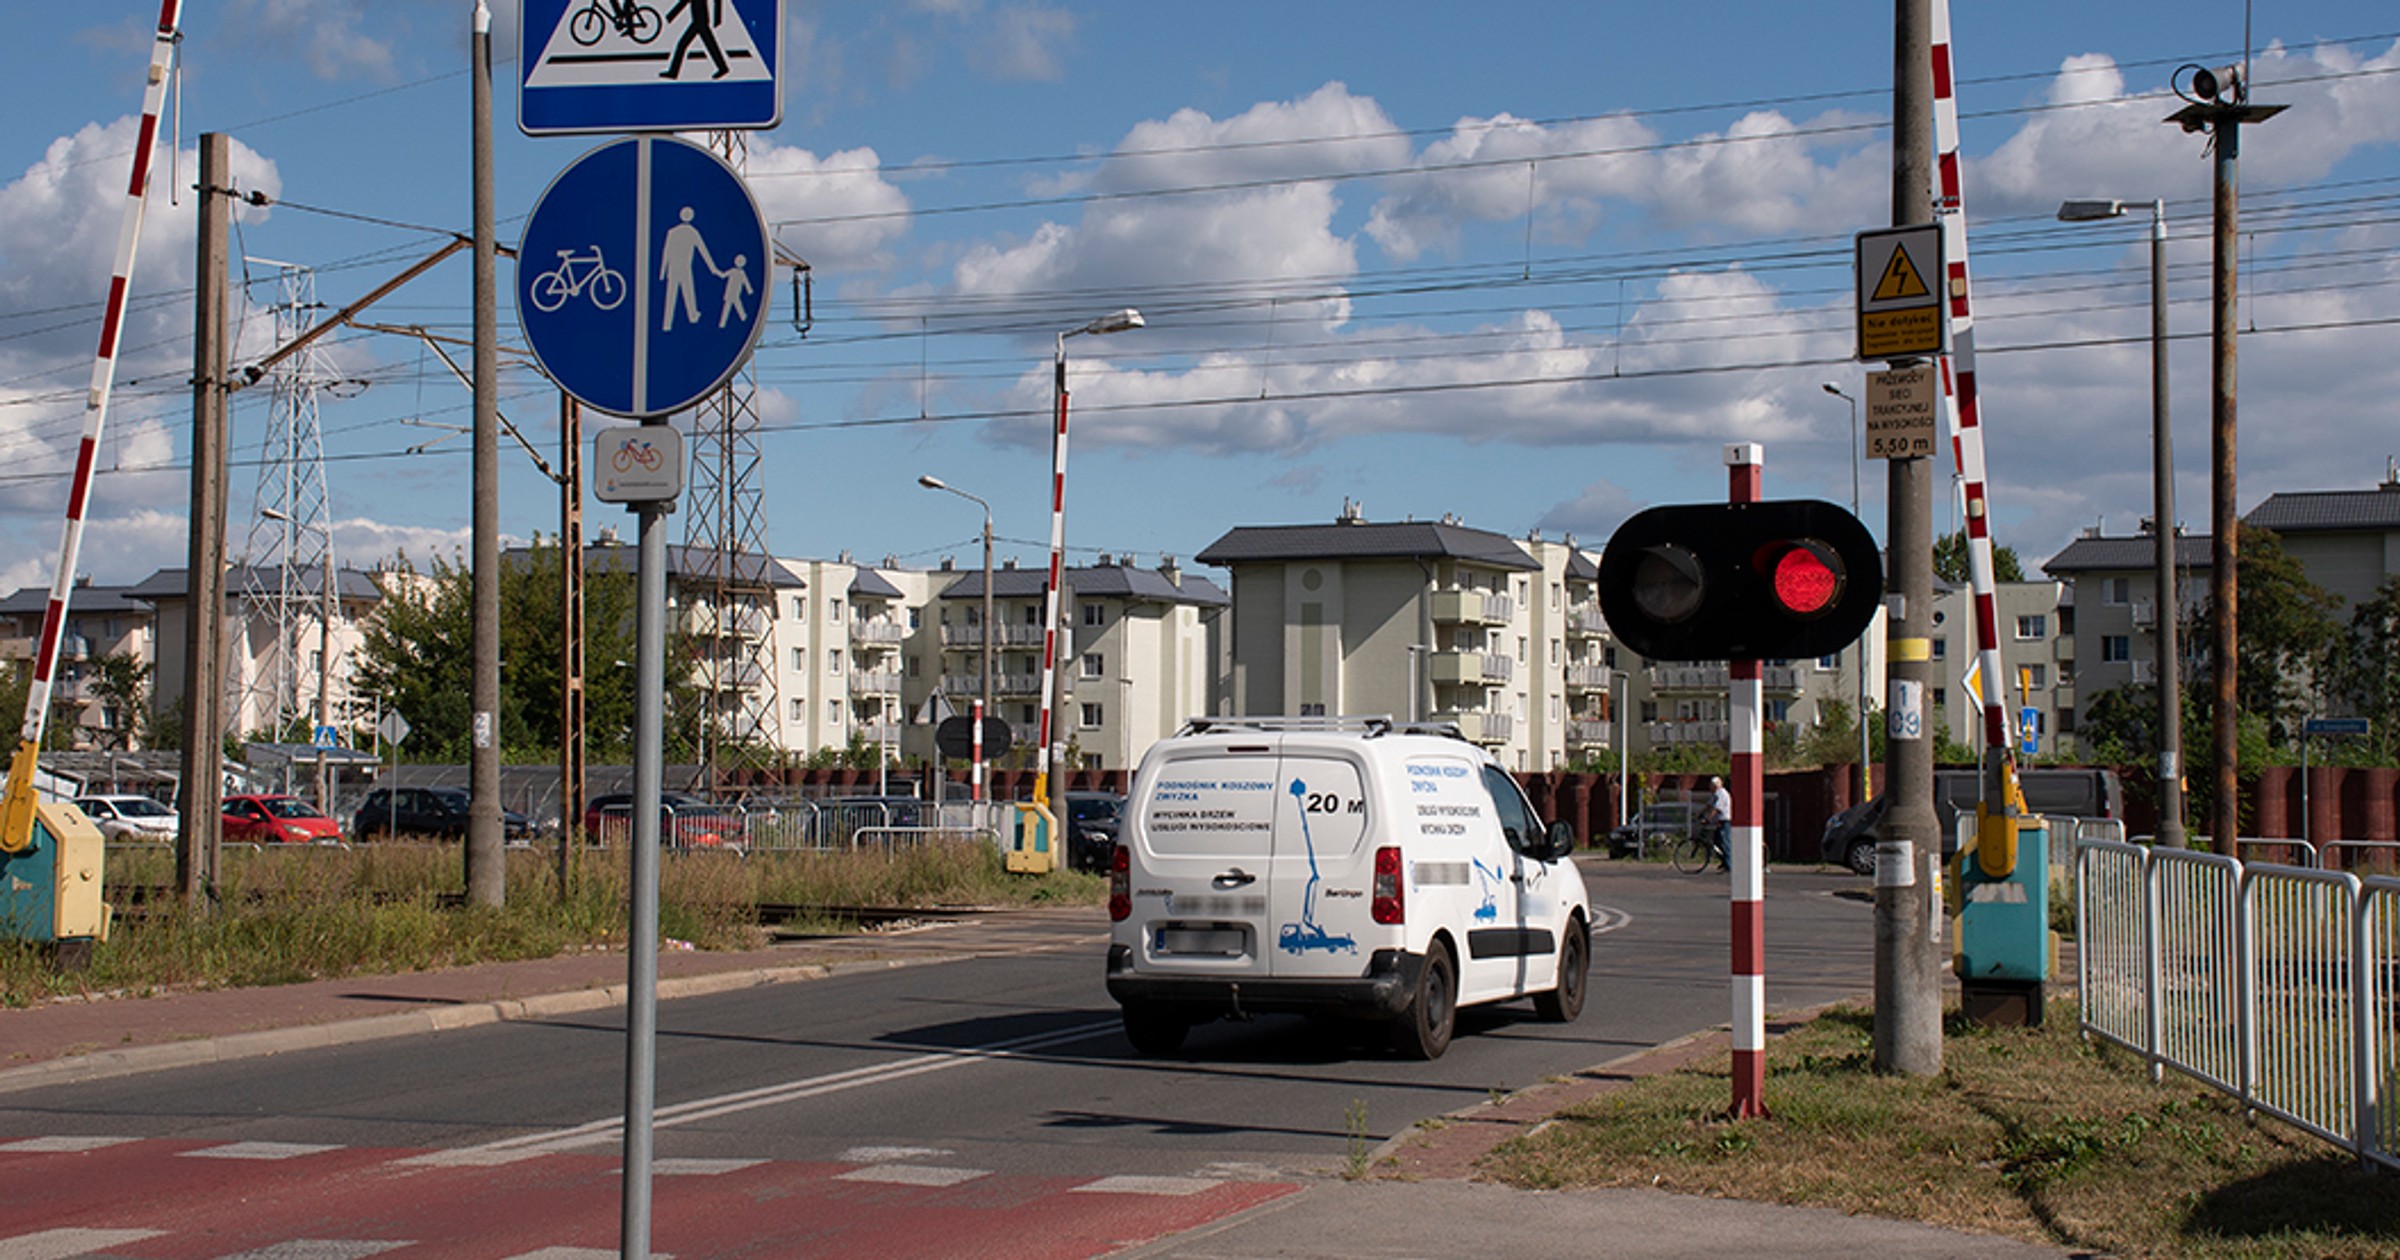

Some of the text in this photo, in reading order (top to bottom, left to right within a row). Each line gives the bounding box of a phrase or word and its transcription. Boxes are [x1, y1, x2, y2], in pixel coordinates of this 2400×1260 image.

[1913, 438, 1928, 450] m
[1733, 447, 1740, 461] 1
[1899, 685, 1906, 706] 1
[1307, 793, 1339, 813] 20
